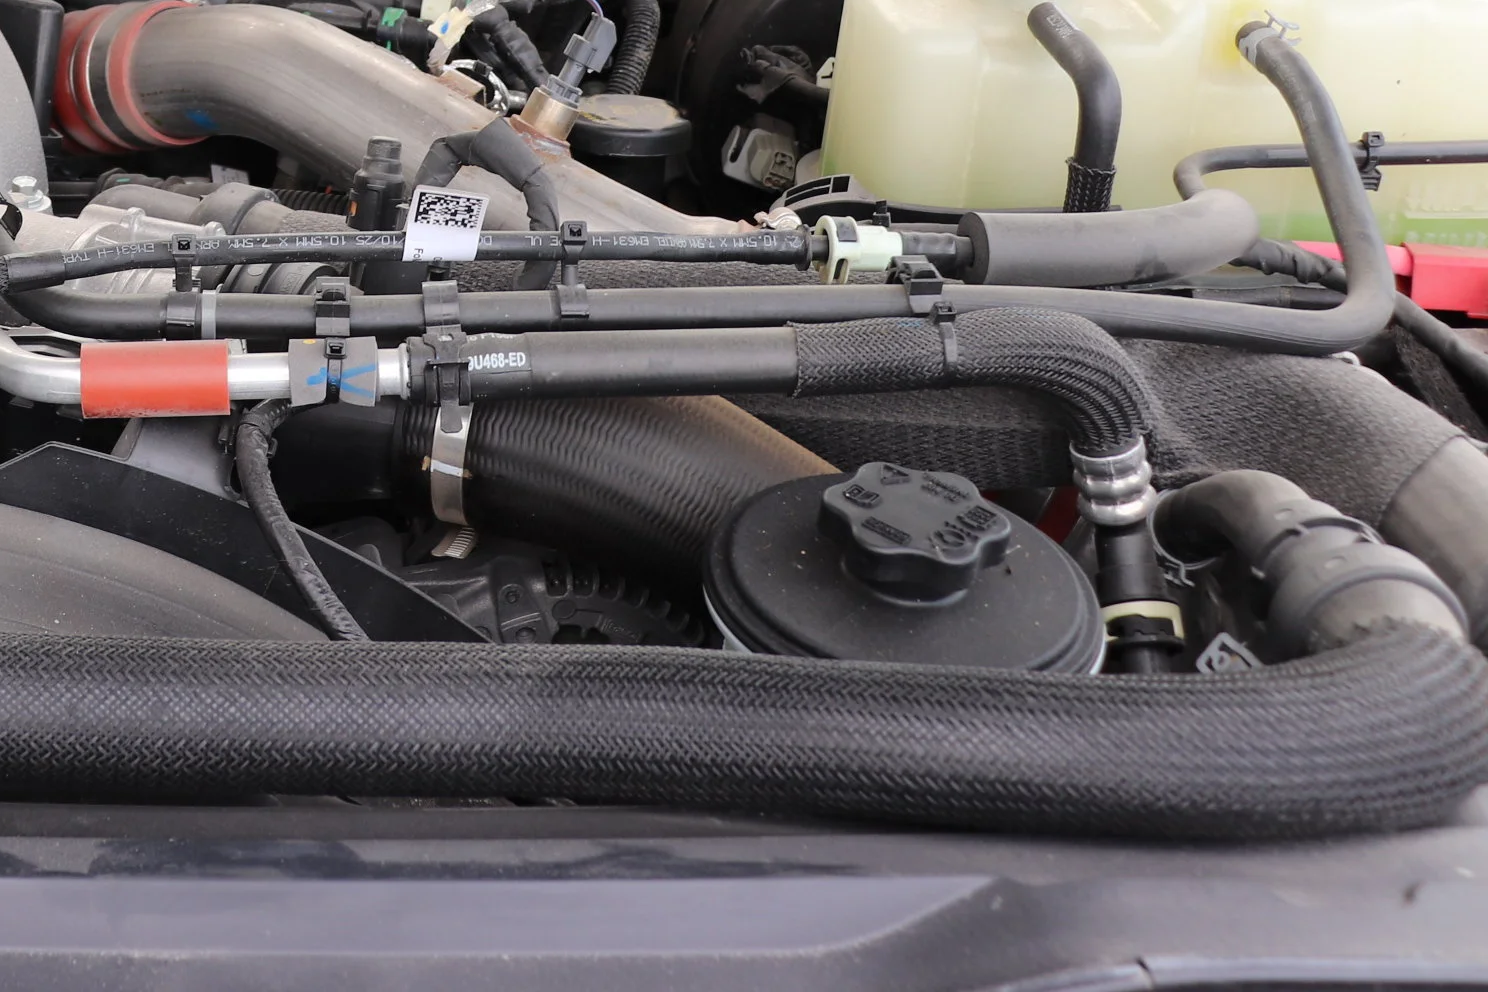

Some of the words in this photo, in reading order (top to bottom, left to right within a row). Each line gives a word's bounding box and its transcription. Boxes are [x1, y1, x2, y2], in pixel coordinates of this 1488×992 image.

[278, 237, 288, 247] X
[295, 235, 346, 249] 10.5MM
[718, 237, 727, 247] X
[97, 243, 155, 259] EM631-H
